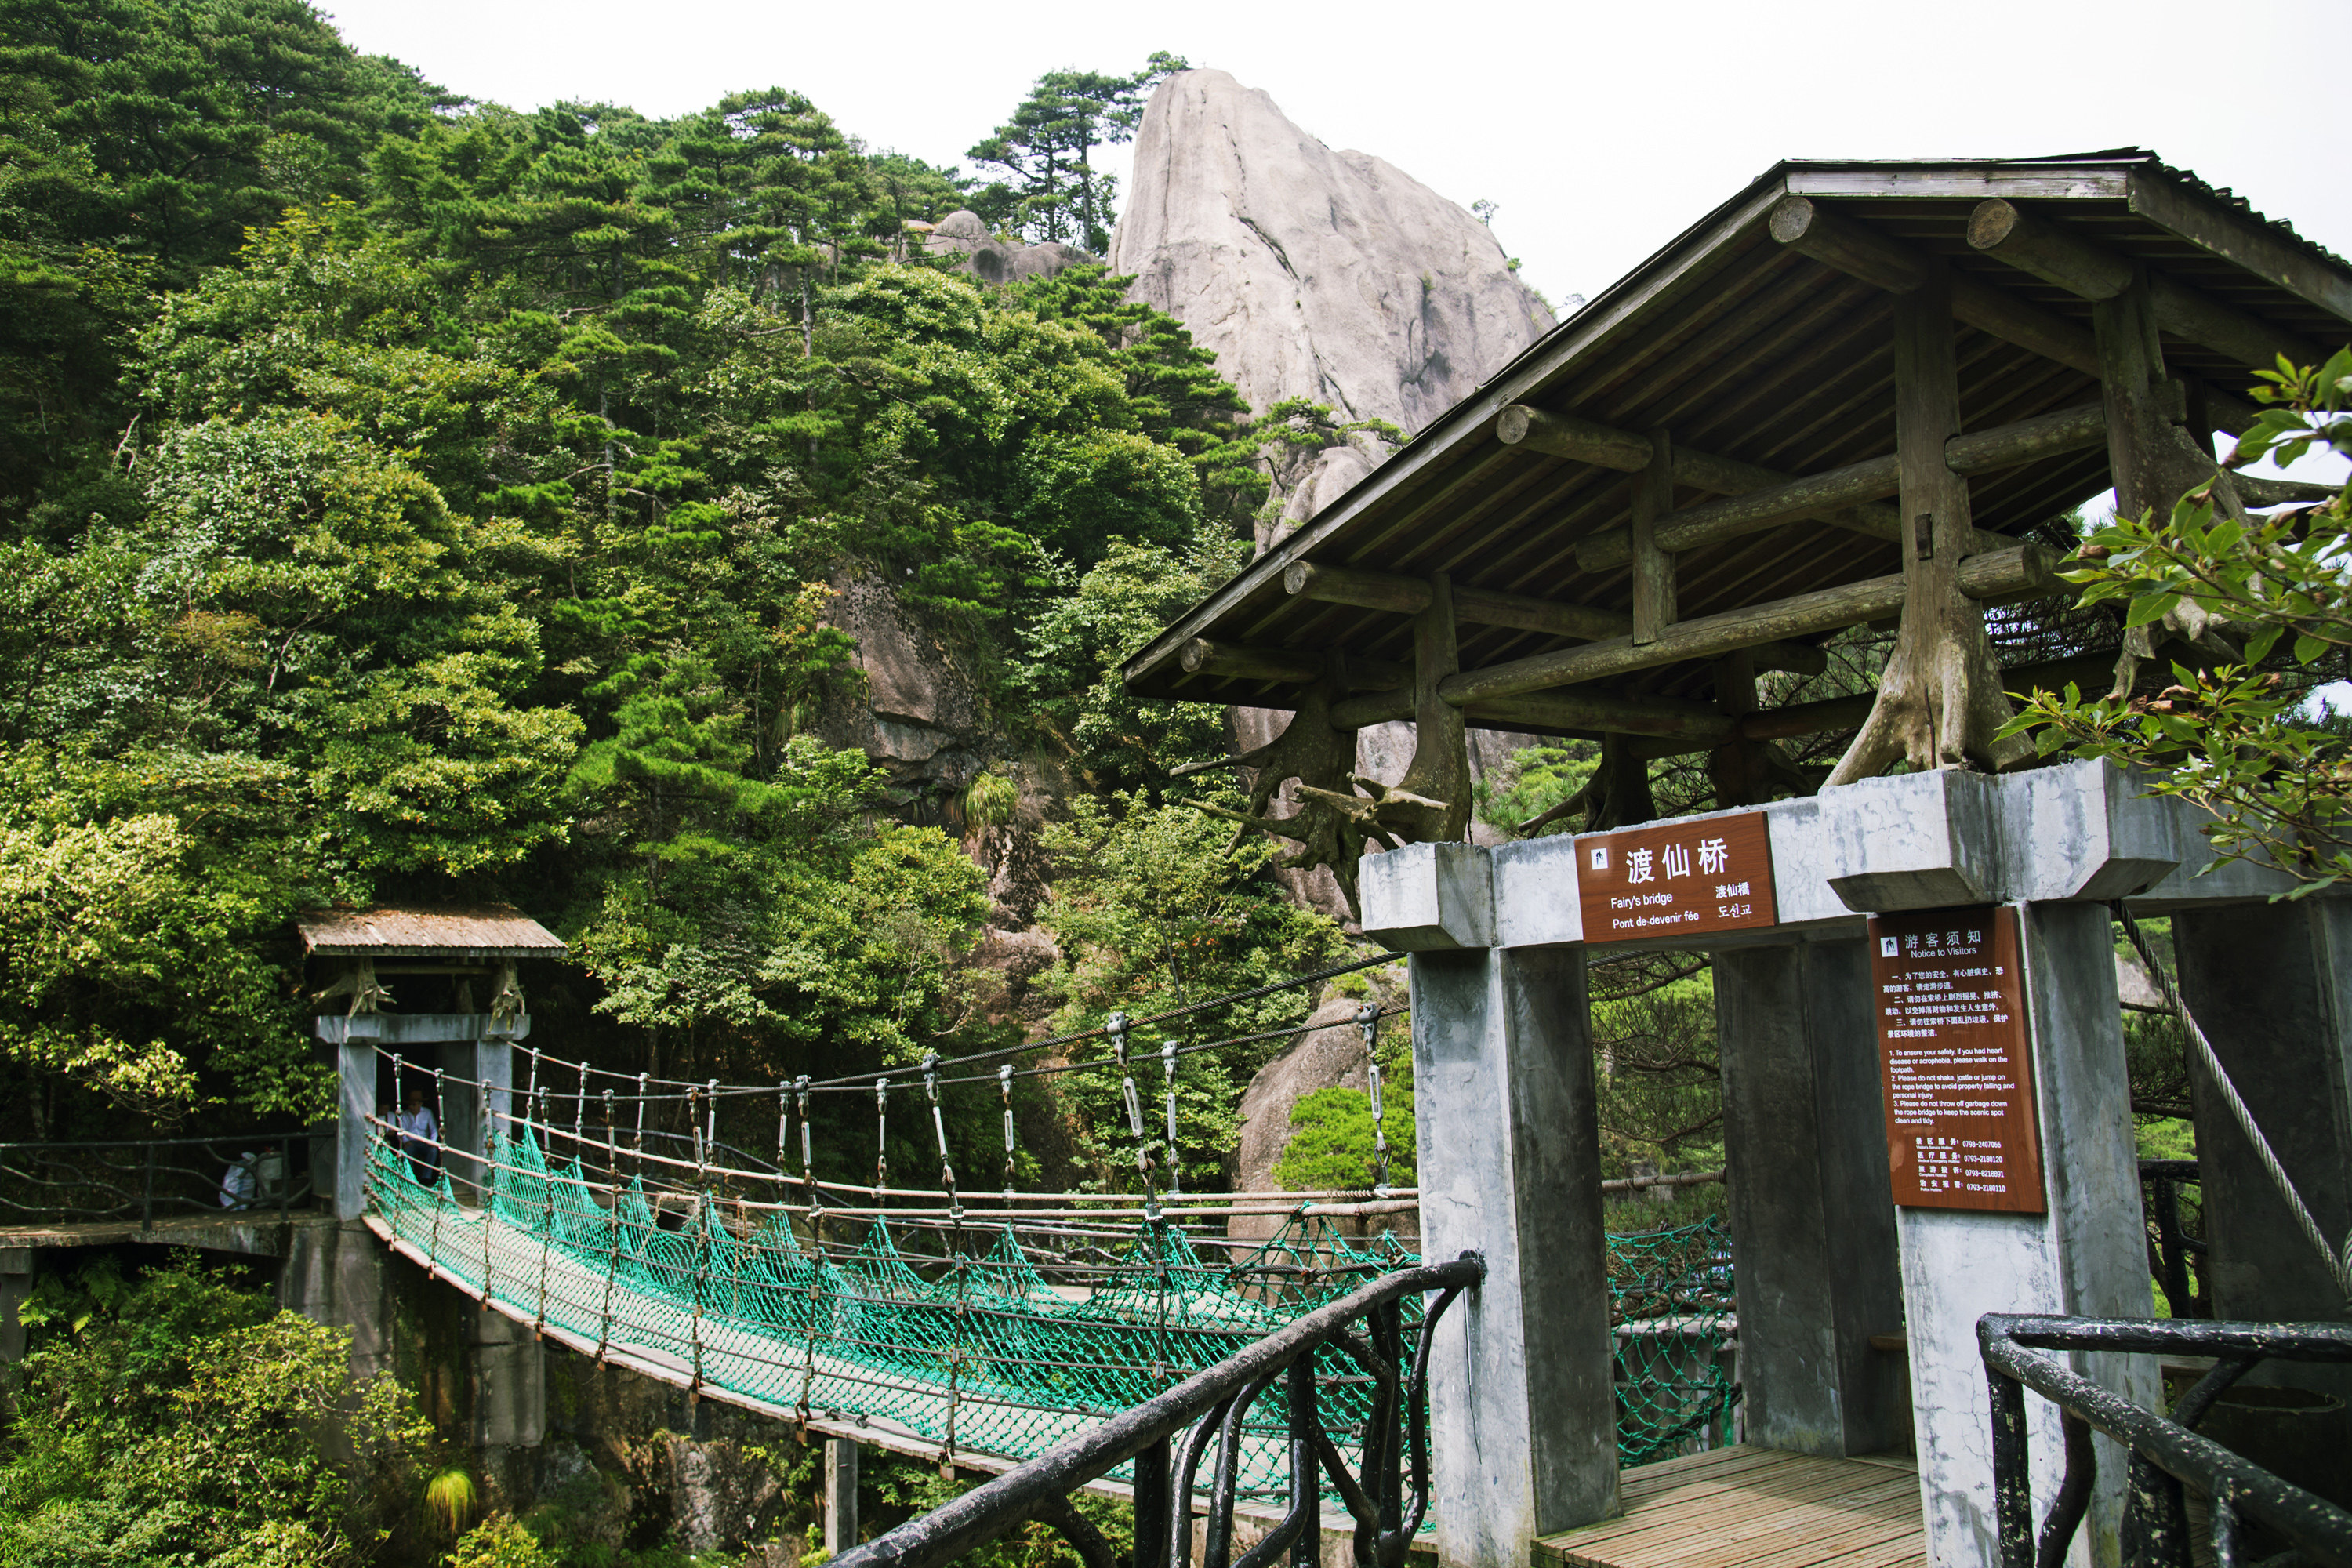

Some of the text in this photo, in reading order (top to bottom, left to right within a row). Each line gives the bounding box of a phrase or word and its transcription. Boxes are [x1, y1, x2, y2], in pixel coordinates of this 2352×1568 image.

[1625, 837, 1729, 884] 渡仙桥
[1715, 881, 1750, 899] 渡仙橋
[1611, 892, 1673, 909] Fairy's bridge
[1613, 910, 1699, 930] Pont de devenir fée
[1718, 903, 1752, 919] 도선교
[1905, 929, 1981, 949] 游客须知
[1967, 1183, 2005, 1192] 0793-2180110
